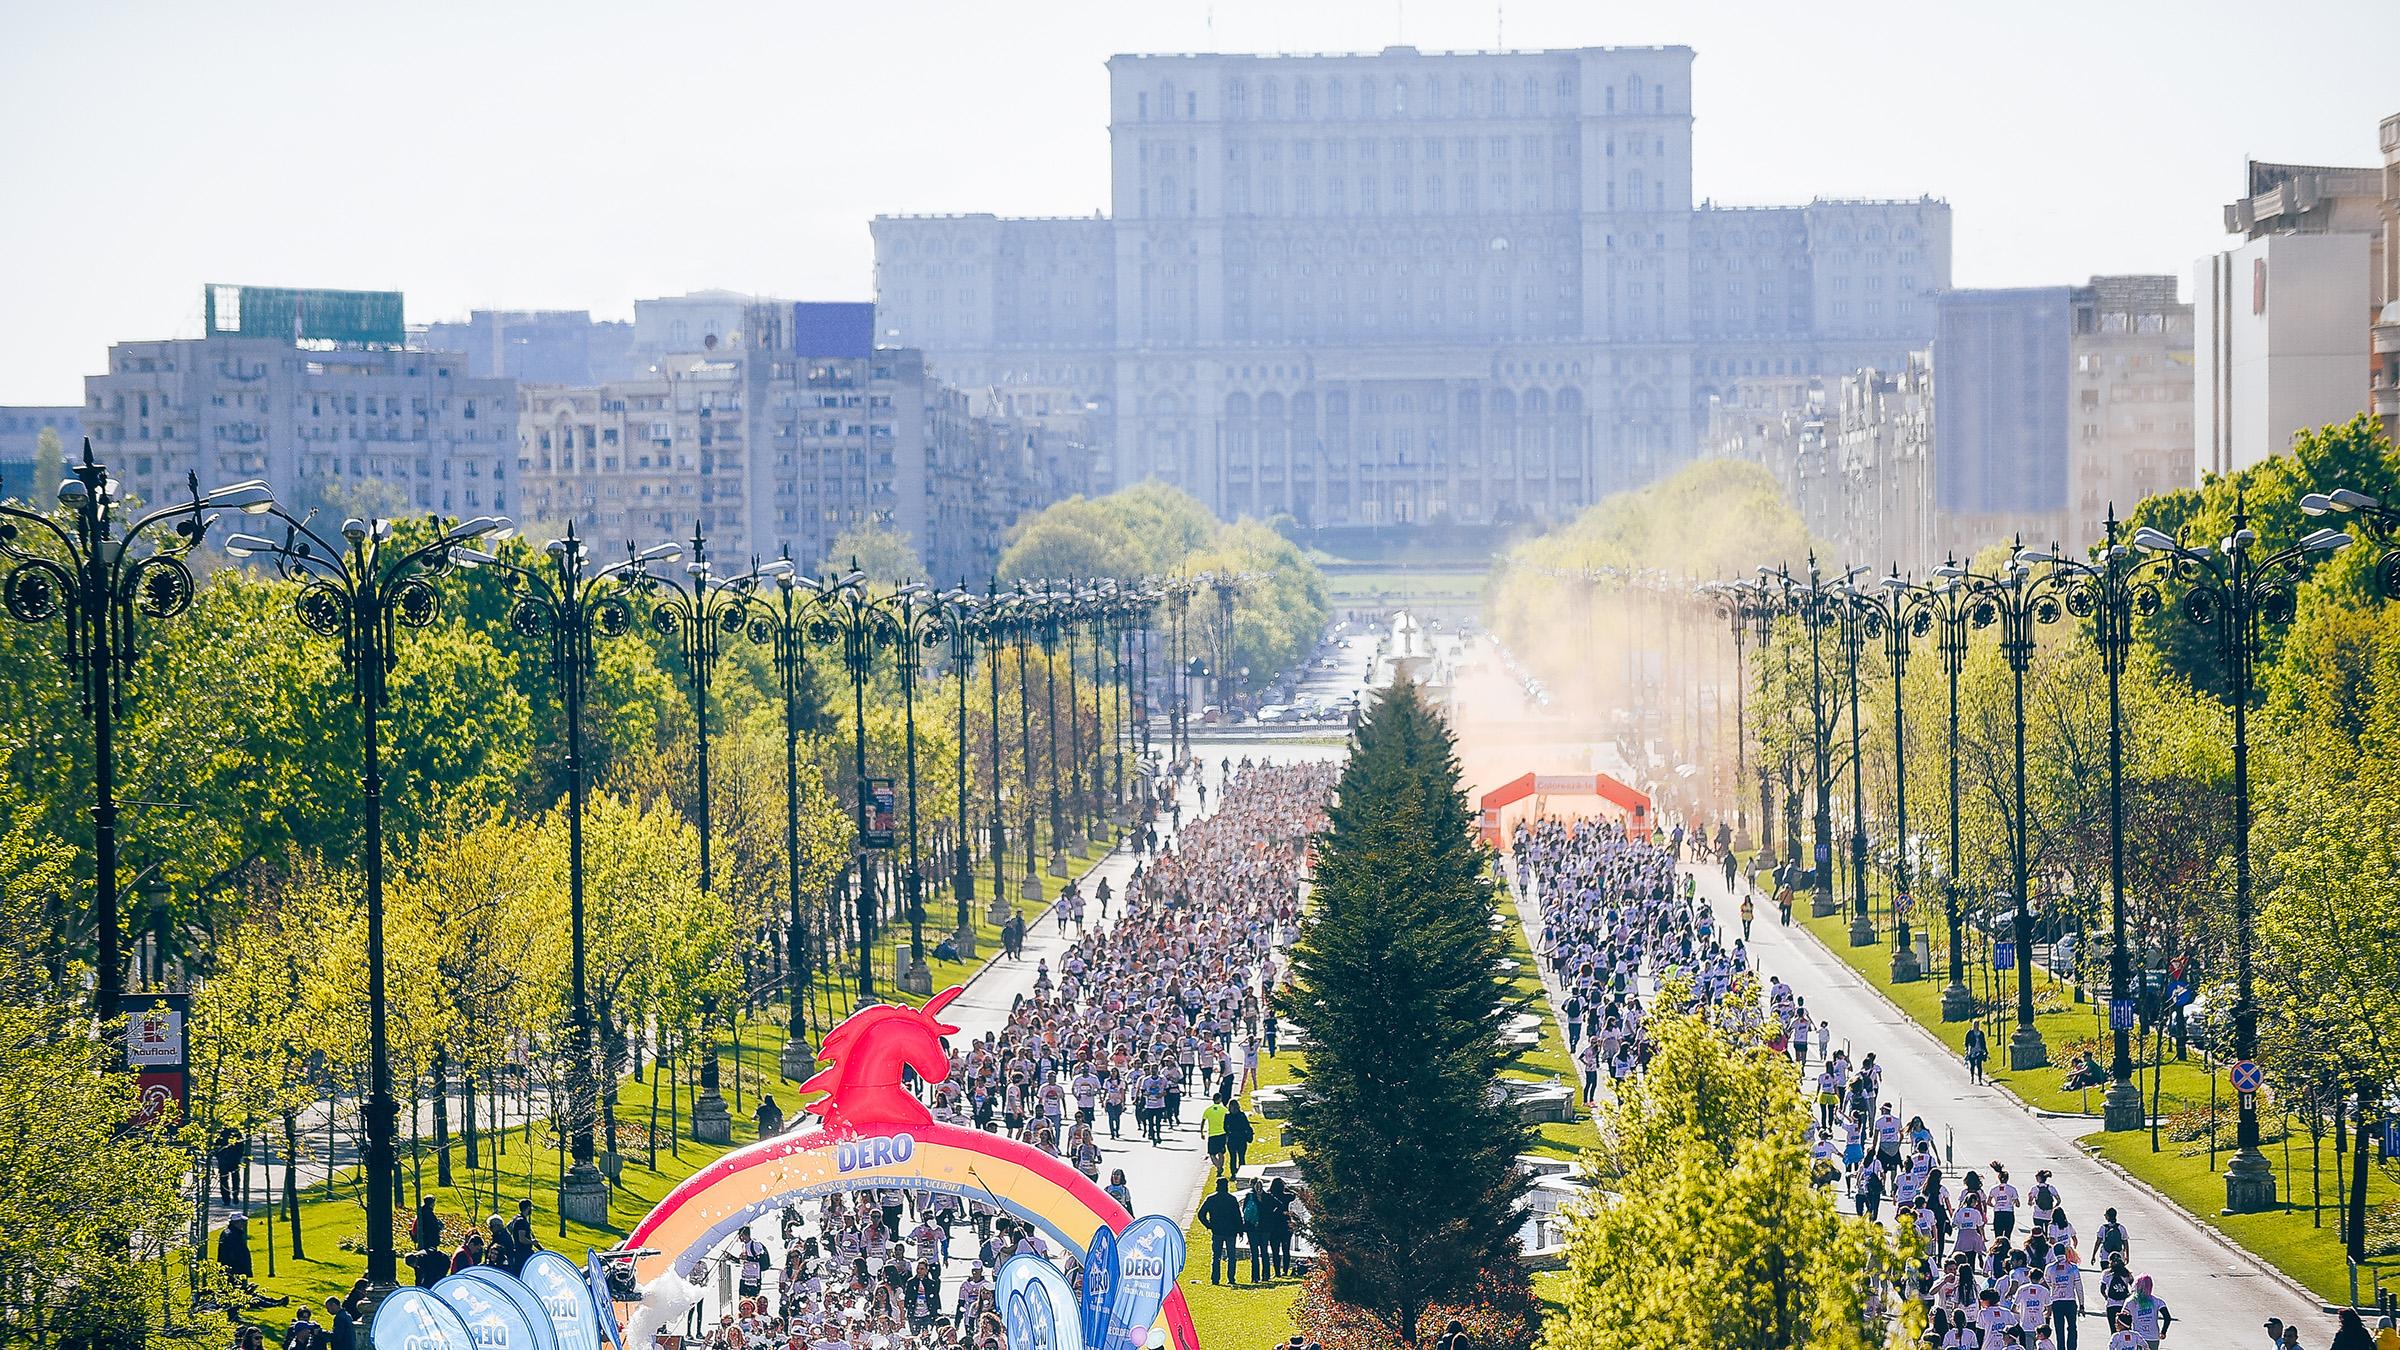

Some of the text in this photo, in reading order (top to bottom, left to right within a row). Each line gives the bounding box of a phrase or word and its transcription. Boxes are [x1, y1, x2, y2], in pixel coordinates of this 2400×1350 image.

[839, 1134, 913, 1172] DERO
[851, 1177, 897, 1189] PRINCIPAL
[1126, 1258, 1162, 1276] DERO
[1090, 1271, 1109, 1293] DERO
